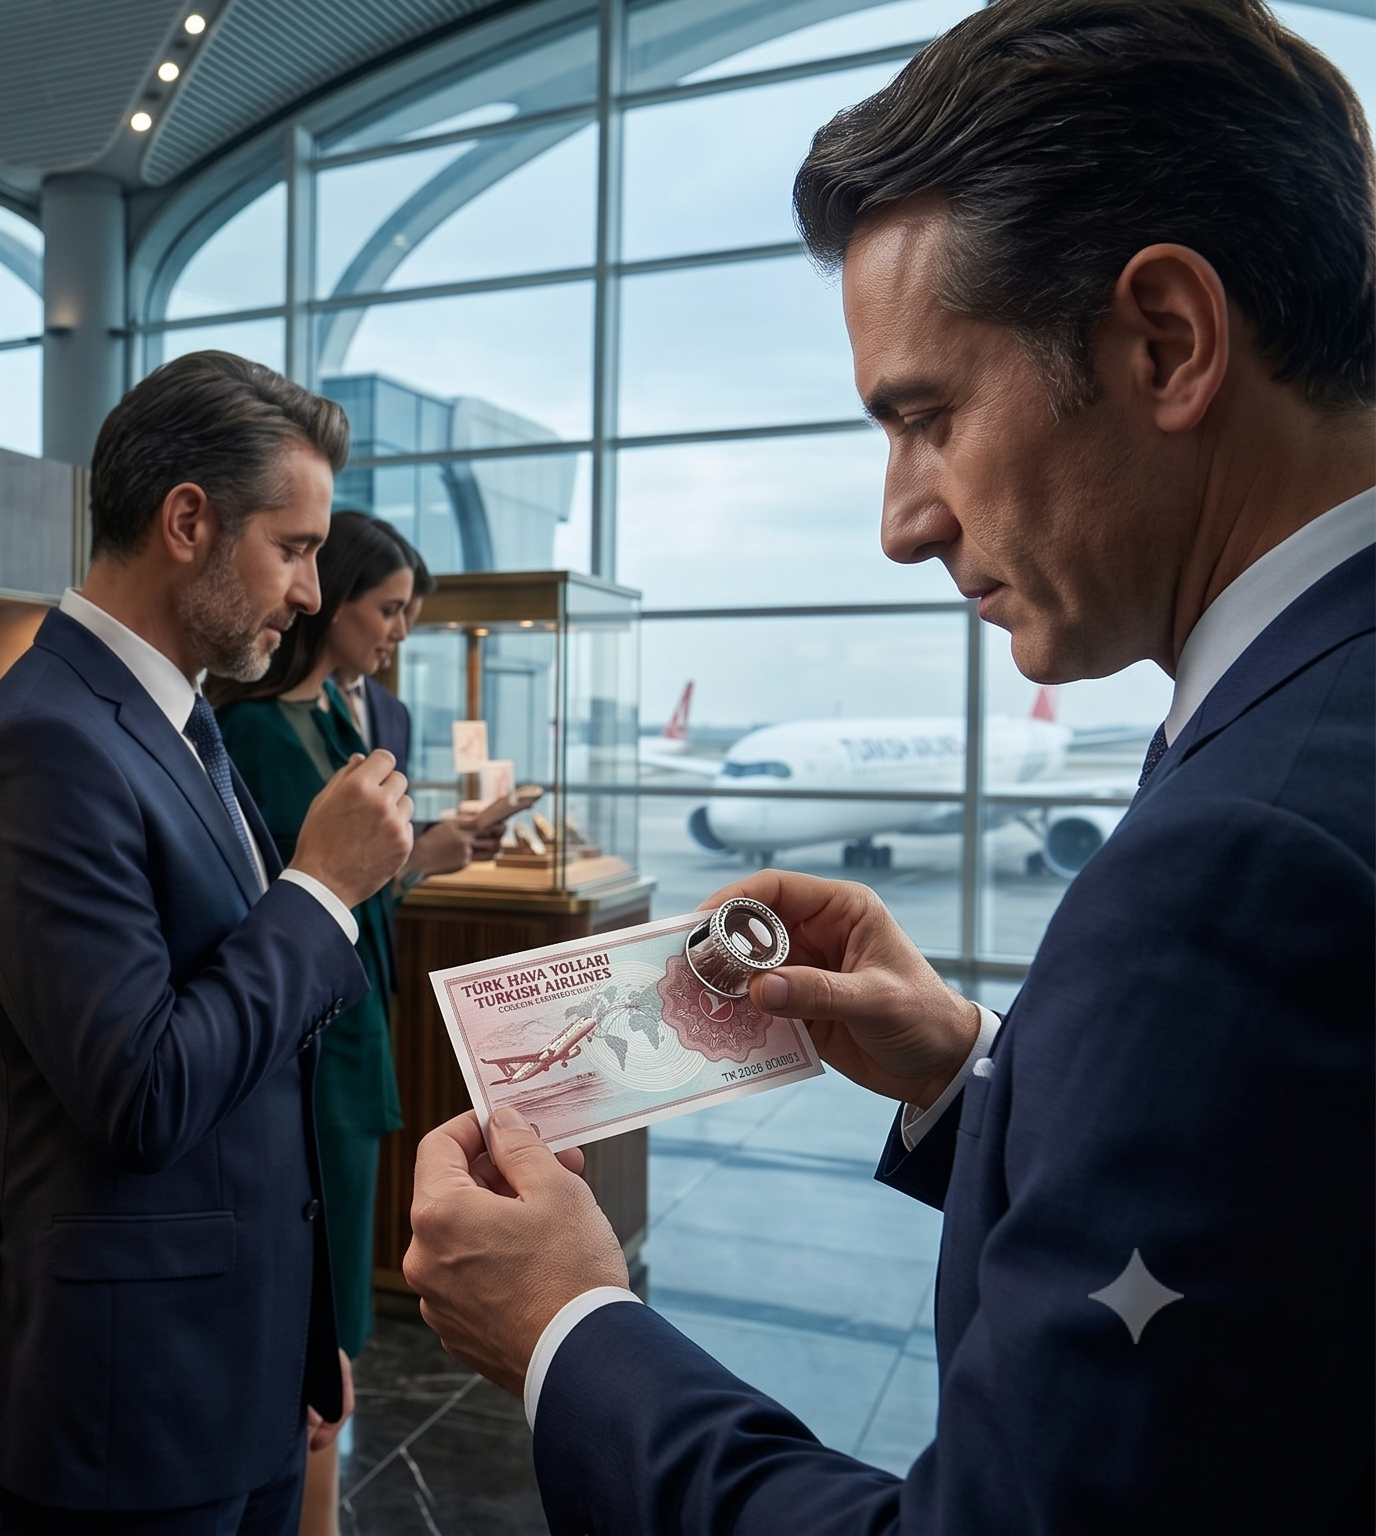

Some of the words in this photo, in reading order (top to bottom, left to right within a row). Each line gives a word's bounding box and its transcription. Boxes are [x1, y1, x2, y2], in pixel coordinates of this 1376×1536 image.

[460, 977, 505, 998] TÜRK
[506, 968, 548, 987] HAVA
[549, 953, 611, 976] YOLLARI
[473, 983, 542, 1009] TURKISH
[545, 967, 612, 993] AIRLINES
